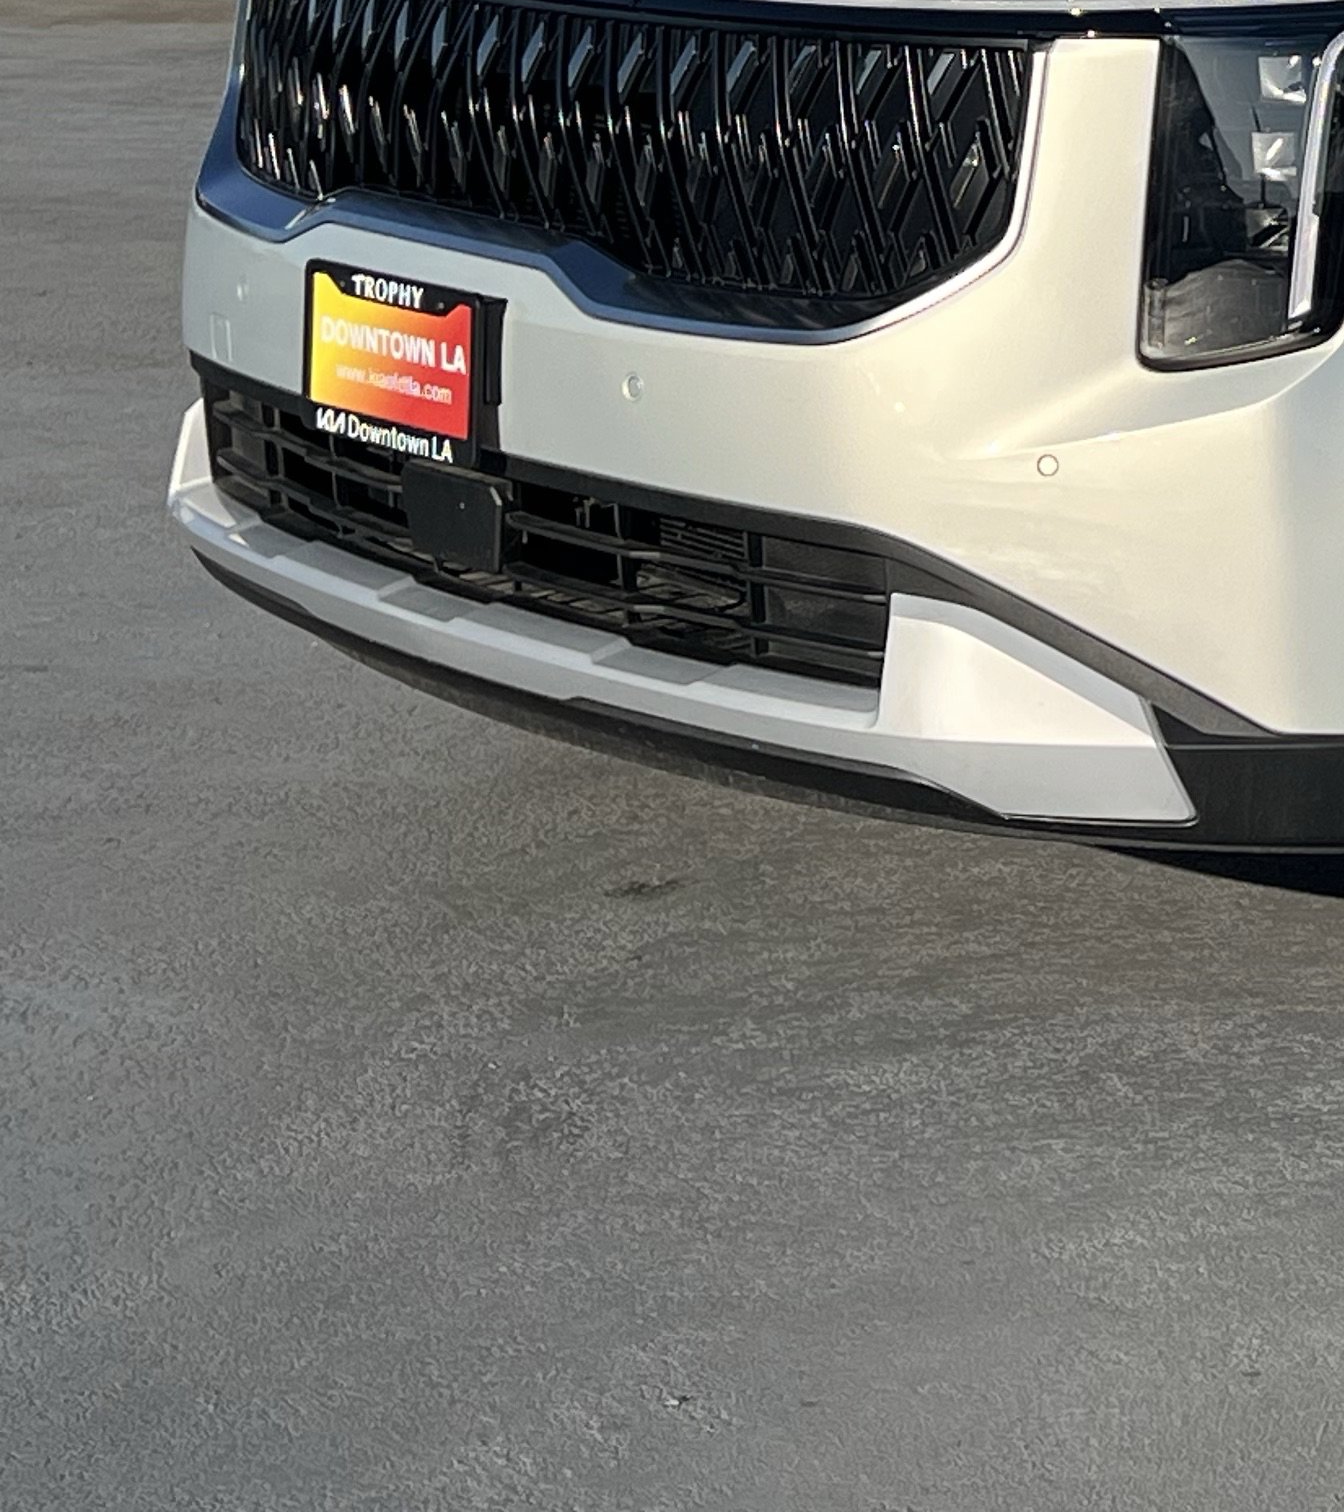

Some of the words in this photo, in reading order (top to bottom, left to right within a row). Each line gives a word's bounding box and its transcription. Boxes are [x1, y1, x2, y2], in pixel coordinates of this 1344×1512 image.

[351, 273, 424, 309] TROPHY
[320, 315, 435, 368] DOWNTOWN
[440, 342, 467, 376] LA
[347, 413, 429, 458] Downtown
[432, 436, 454, 464] LA
